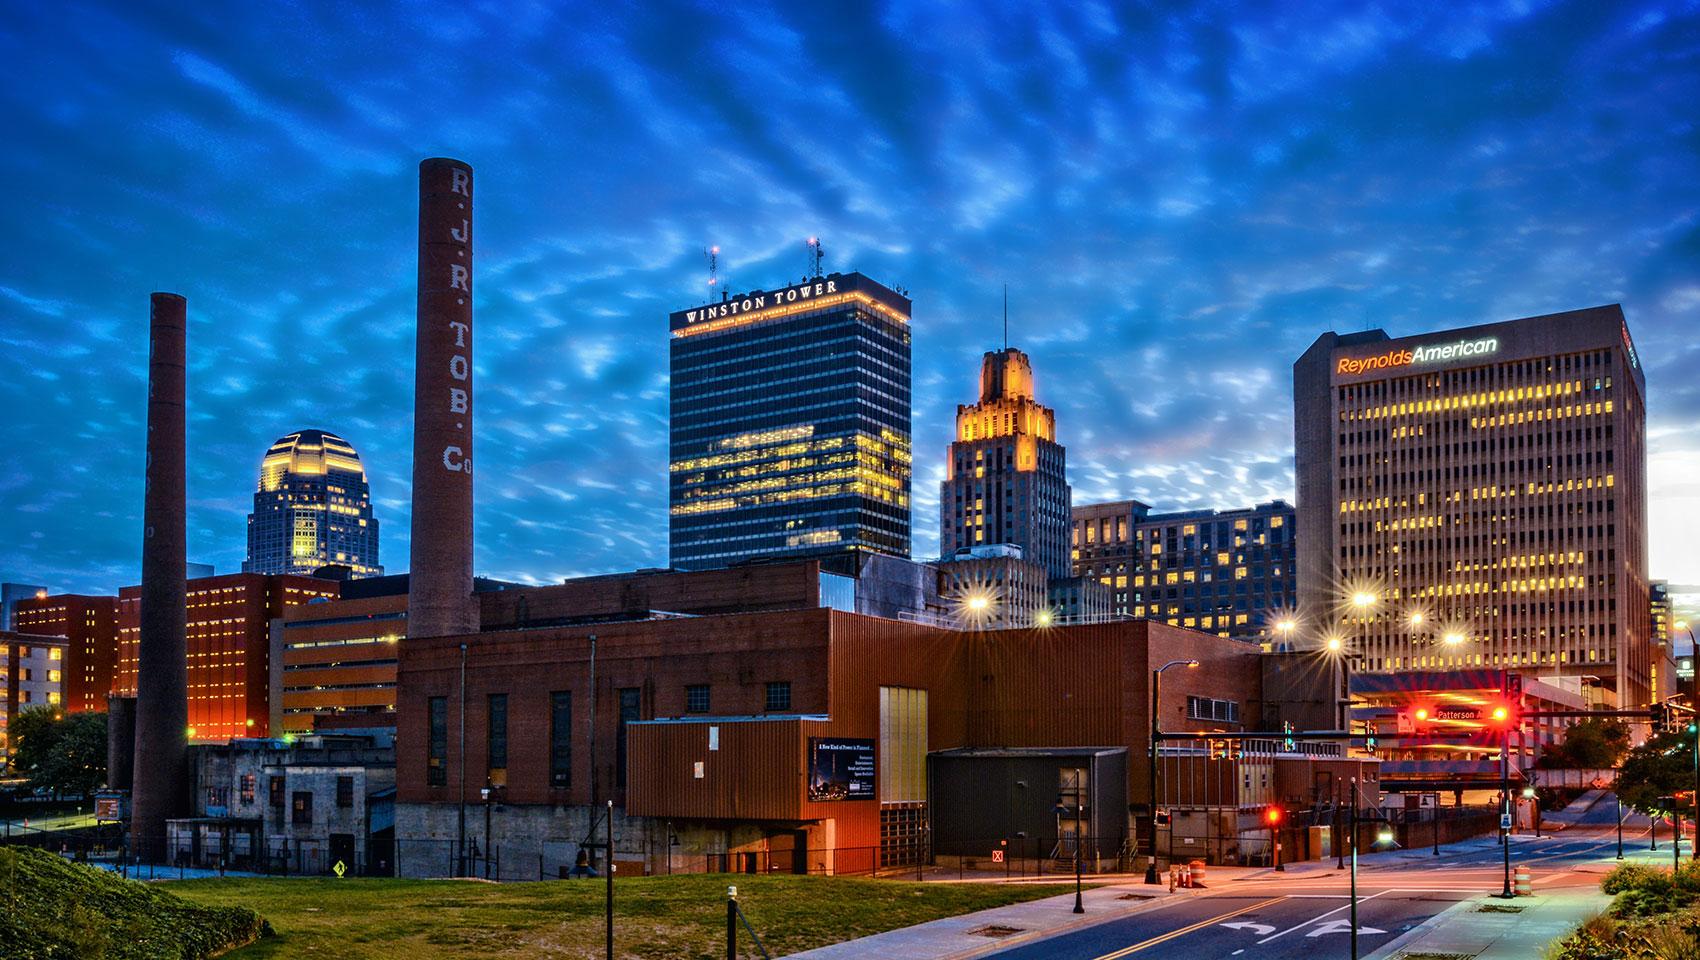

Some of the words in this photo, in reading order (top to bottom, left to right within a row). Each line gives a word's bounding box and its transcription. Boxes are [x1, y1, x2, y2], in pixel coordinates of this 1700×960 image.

[686, 296, 765, 323] WINSTON
[774, 280, 837, 304] TOWER
[1438, 711, 1475, 719] Patterson
